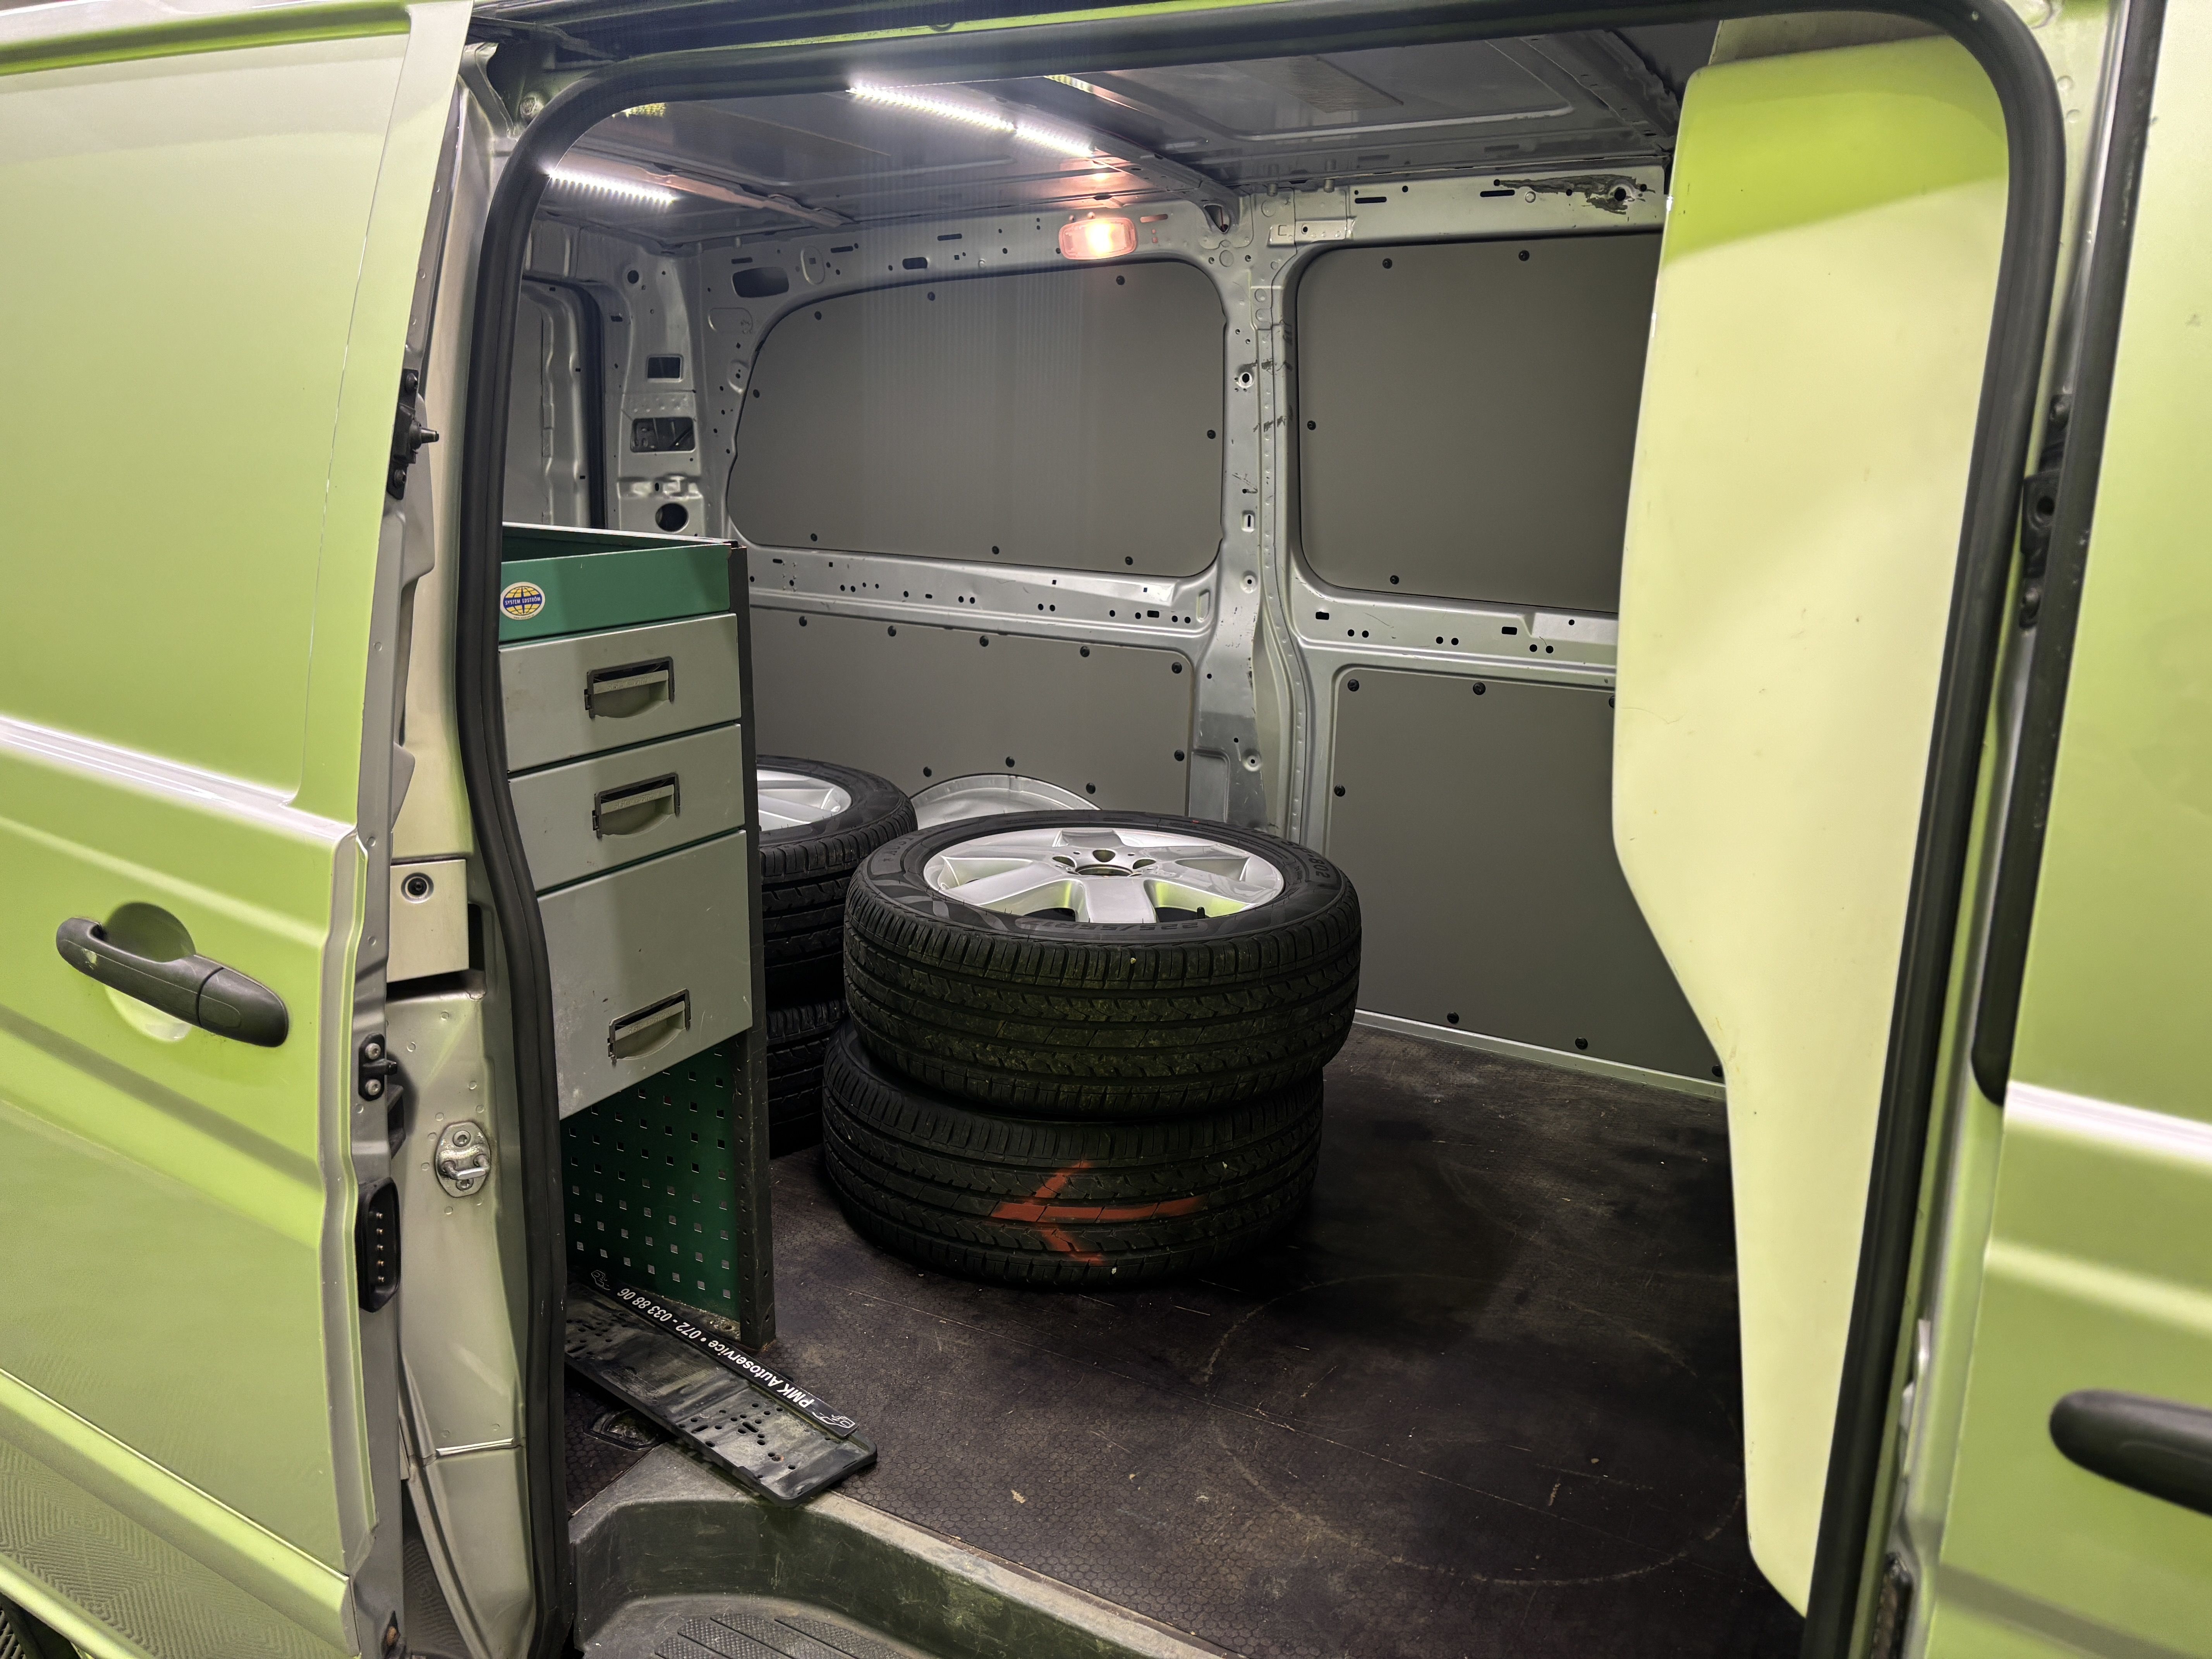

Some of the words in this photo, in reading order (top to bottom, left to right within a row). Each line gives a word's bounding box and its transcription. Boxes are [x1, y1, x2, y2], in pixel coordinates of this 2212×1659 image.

[617, 1288, 636, 1300] 06
[632, 1297, 651, 1309] 88
[647, 1305, 673, 1321] 033
[675, 1322, 702, 1339] 072
[708, 1340, 784, 1388] Autoservice
[776, 1383, 815, 1408] PMK
